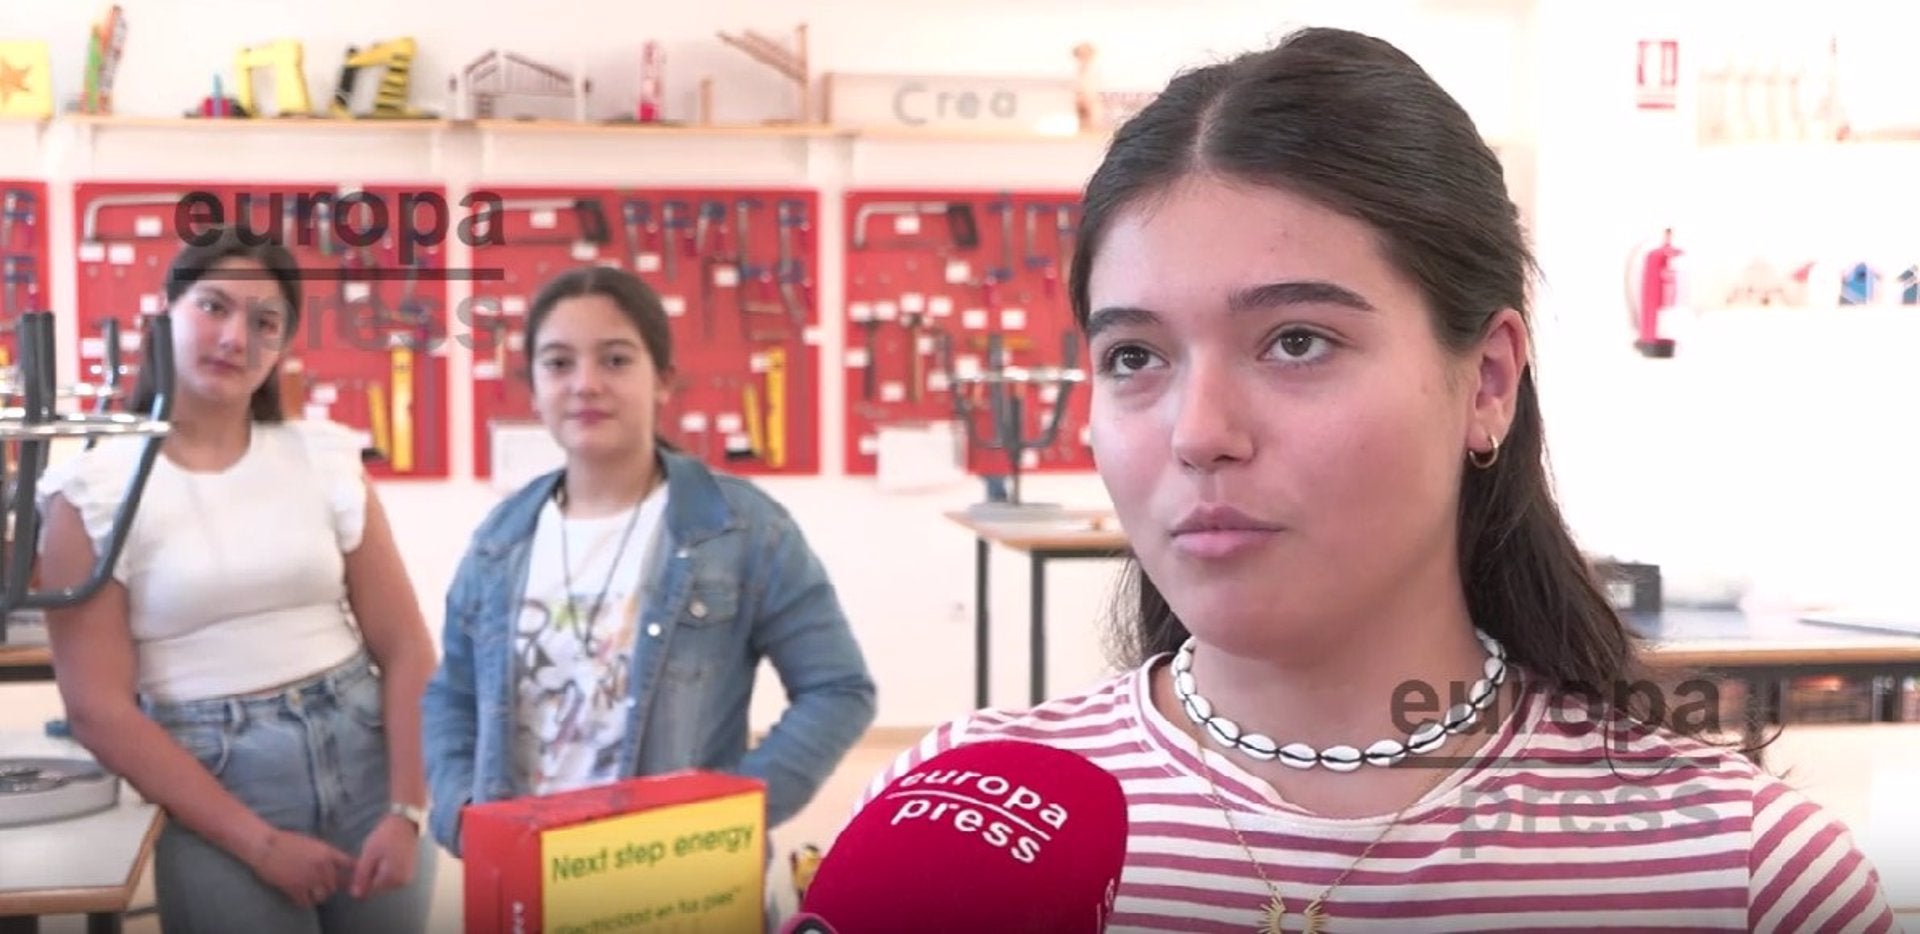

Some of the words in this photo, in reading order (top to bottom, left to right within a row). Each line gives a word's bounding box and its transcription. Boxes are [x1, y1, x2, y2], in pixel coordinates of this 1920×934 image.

[893, 81, 1017, 126] Crea
[899, 767, 1068, 830] europa
[552, 846, 607, 882] Next
[613, 840, 666, 869] step
[673, 822, 754, 857] energy
[890, 798, 1041, 864] press
